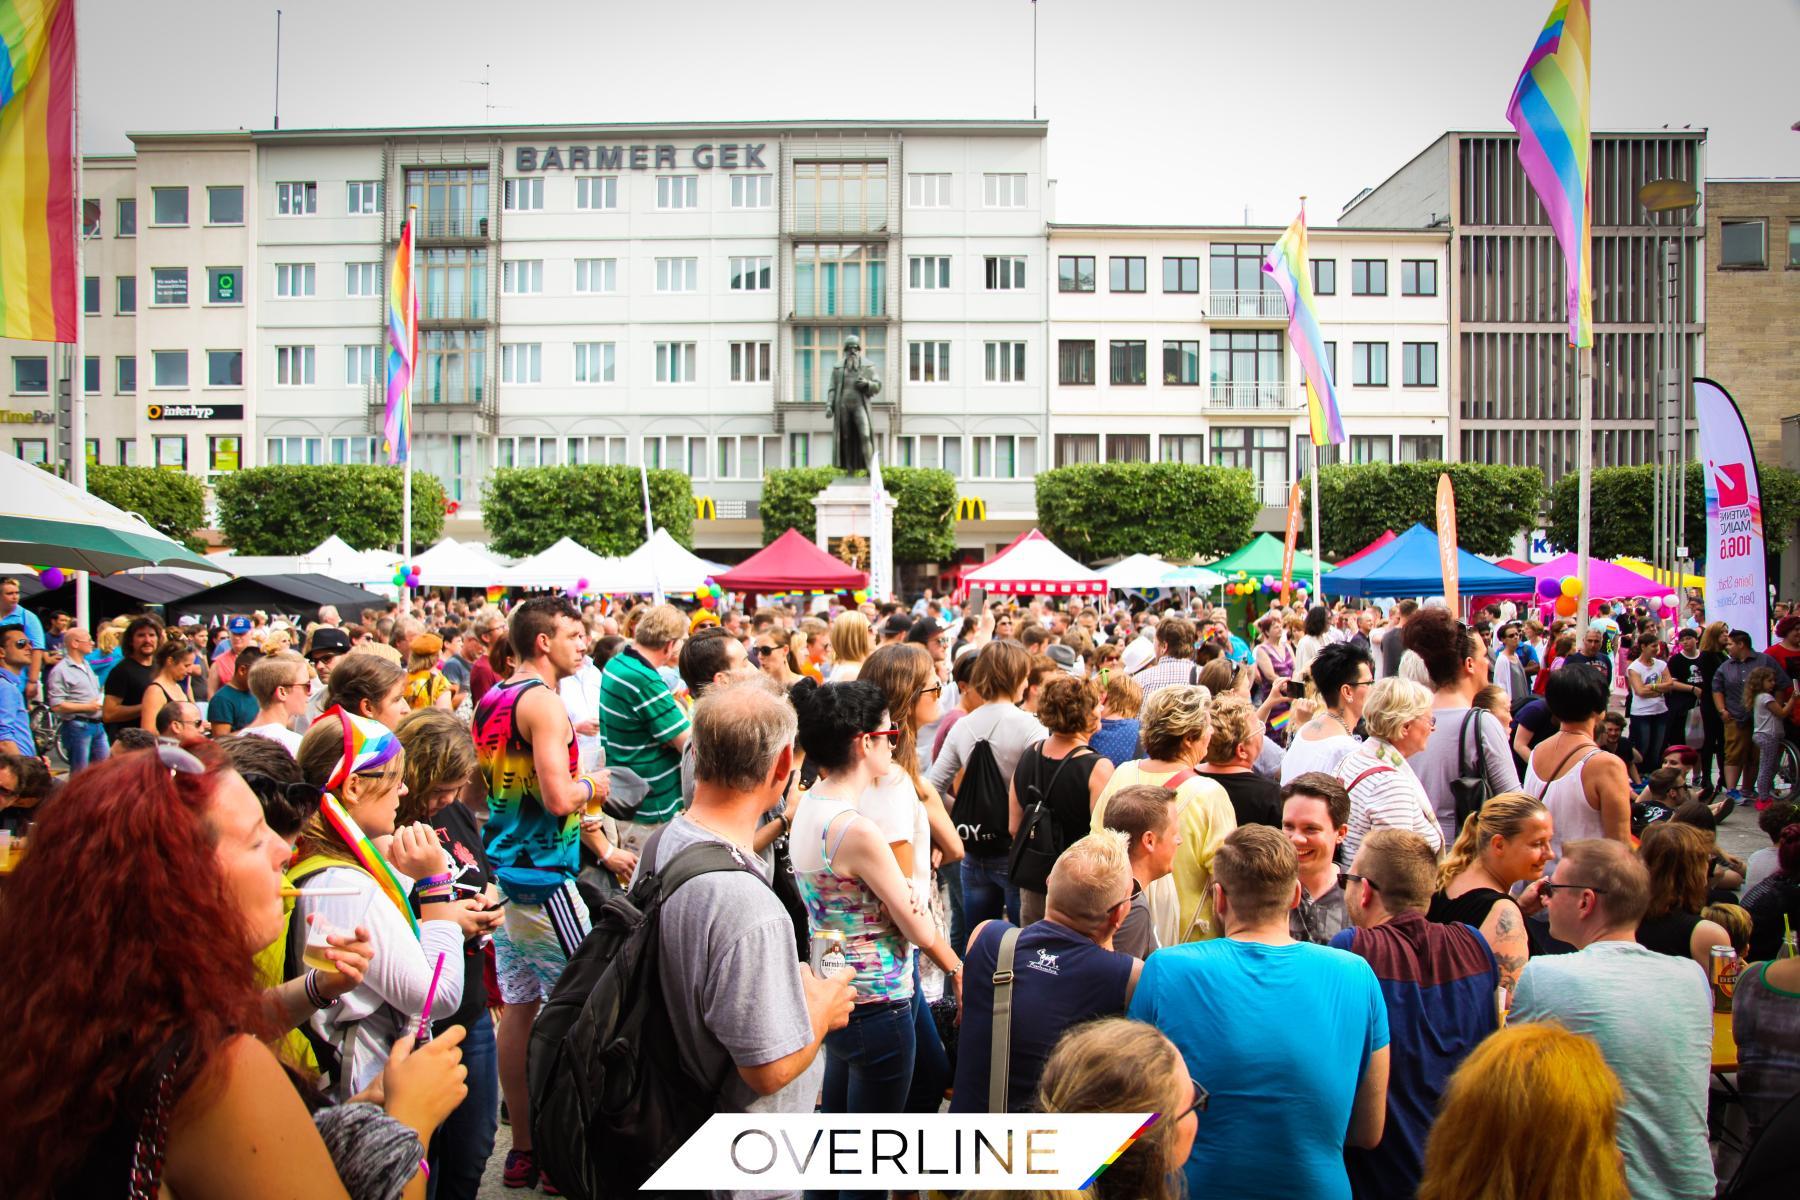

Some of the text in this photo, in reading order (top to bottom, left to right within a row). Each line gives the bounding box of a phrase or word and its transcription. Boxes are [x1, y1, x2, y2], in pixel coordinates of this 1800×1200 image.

[515, 143, 767, 172] BARMER GEK
[164, 406, 214, 419] interhyp
